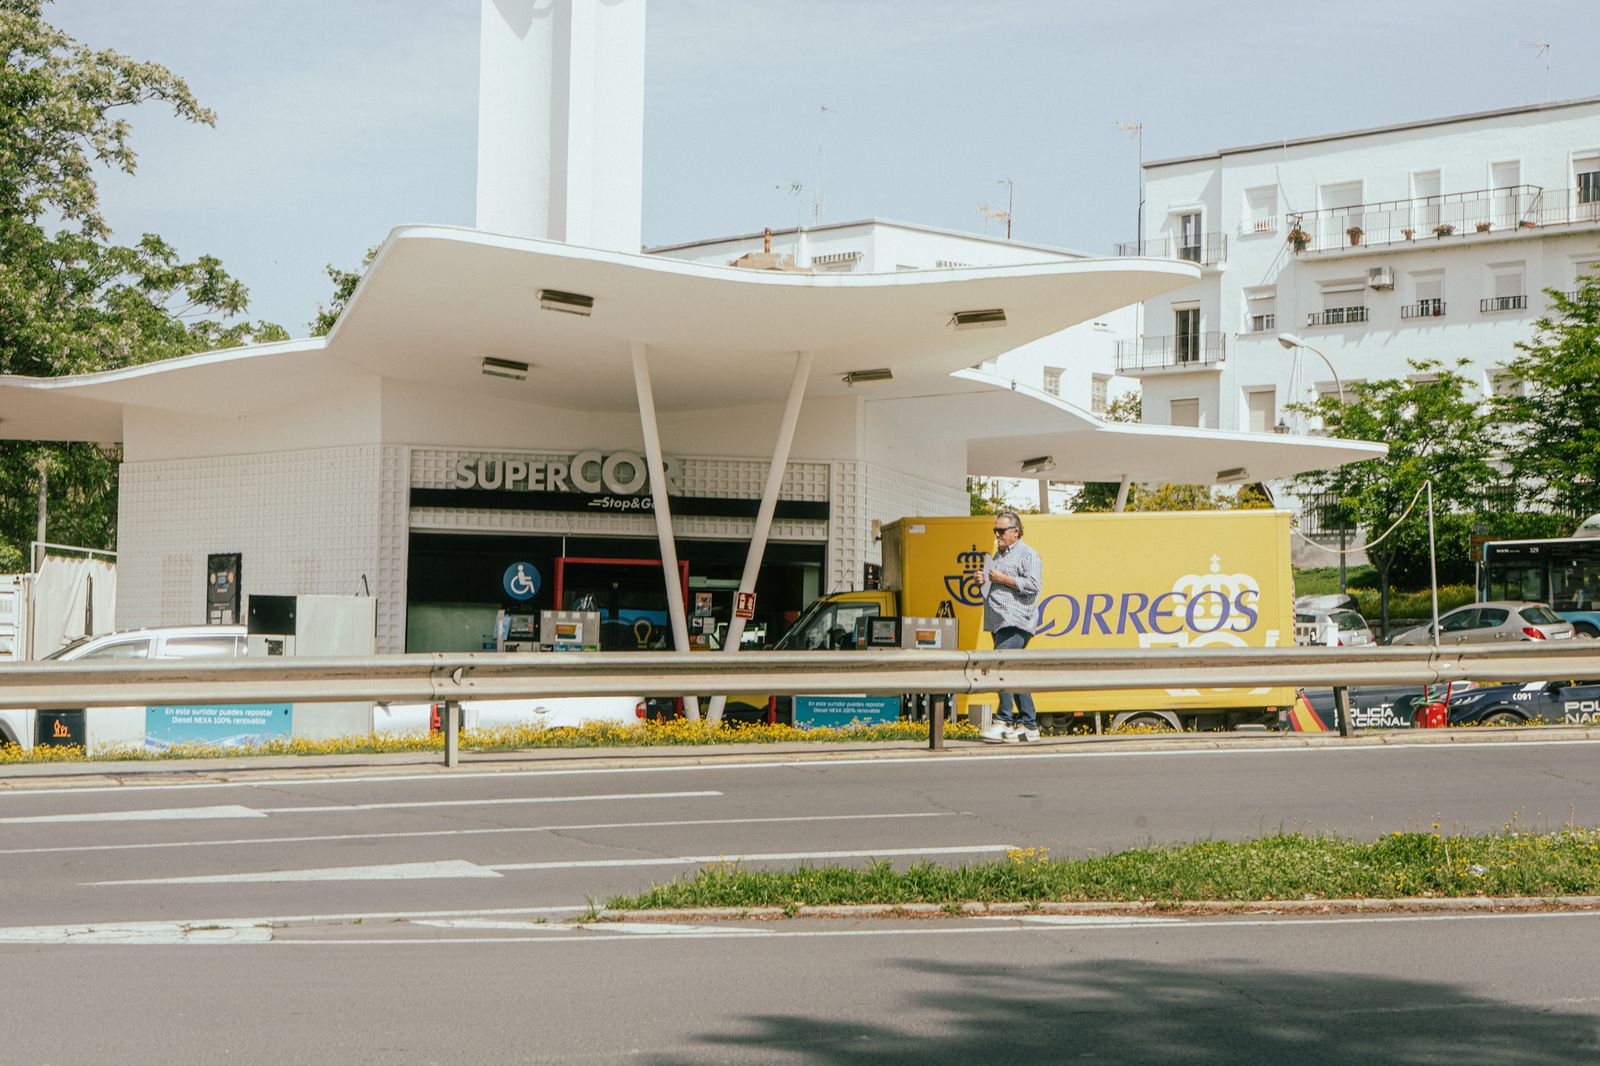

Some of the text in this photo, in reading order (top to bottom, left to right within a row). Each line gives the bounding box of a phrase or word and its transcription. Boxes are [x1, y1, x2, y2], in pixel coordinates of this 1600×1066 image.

[1036, 590, 1259, 636] ORREOS
[192, 708, 218, 716] surtidor
[219, 708, 243, 716] puedes
[245, 709, 273, 717] repostar
[232, 717, 266, 725] renovable
